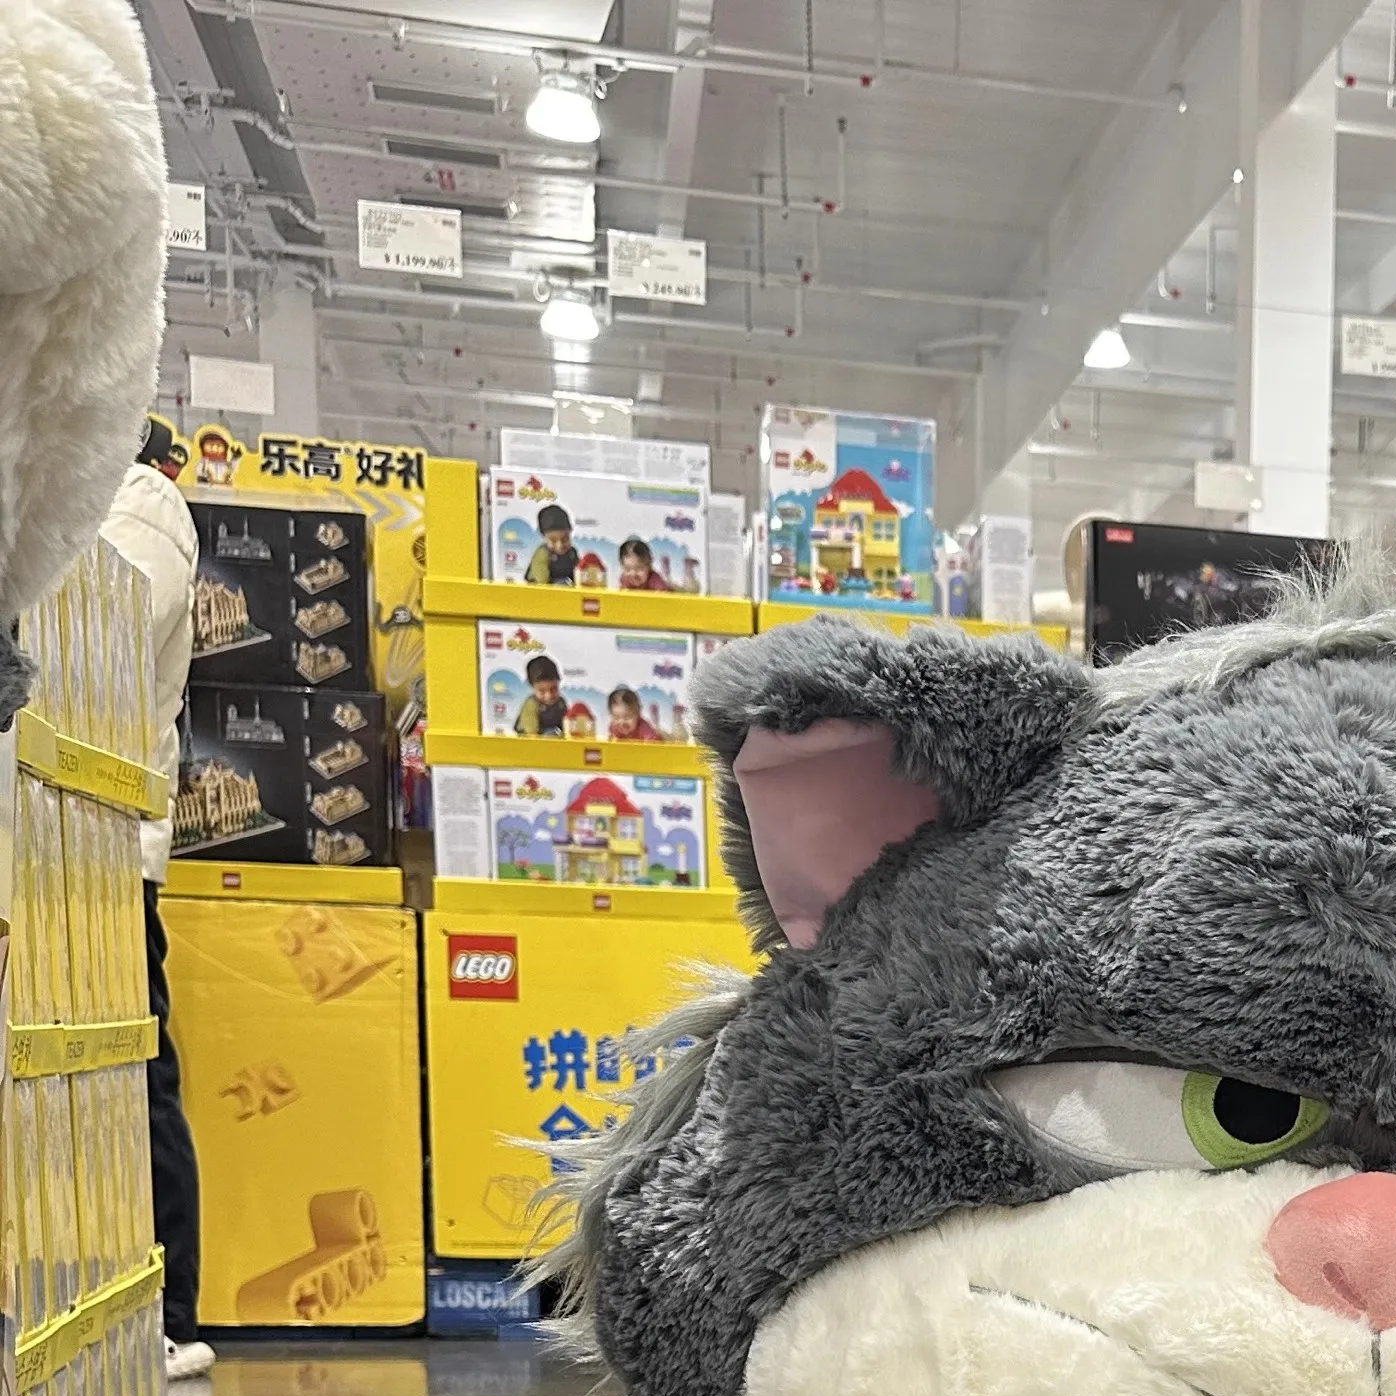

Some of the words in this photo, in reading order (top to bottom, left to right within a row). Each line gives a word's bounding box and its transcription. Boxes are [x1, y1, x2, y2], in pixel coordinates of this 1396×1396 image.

[261, 439, 341, 481] 乐高
[356, 448, 425, 490] 好礼
[453, 954, 514, 981] LEGO
